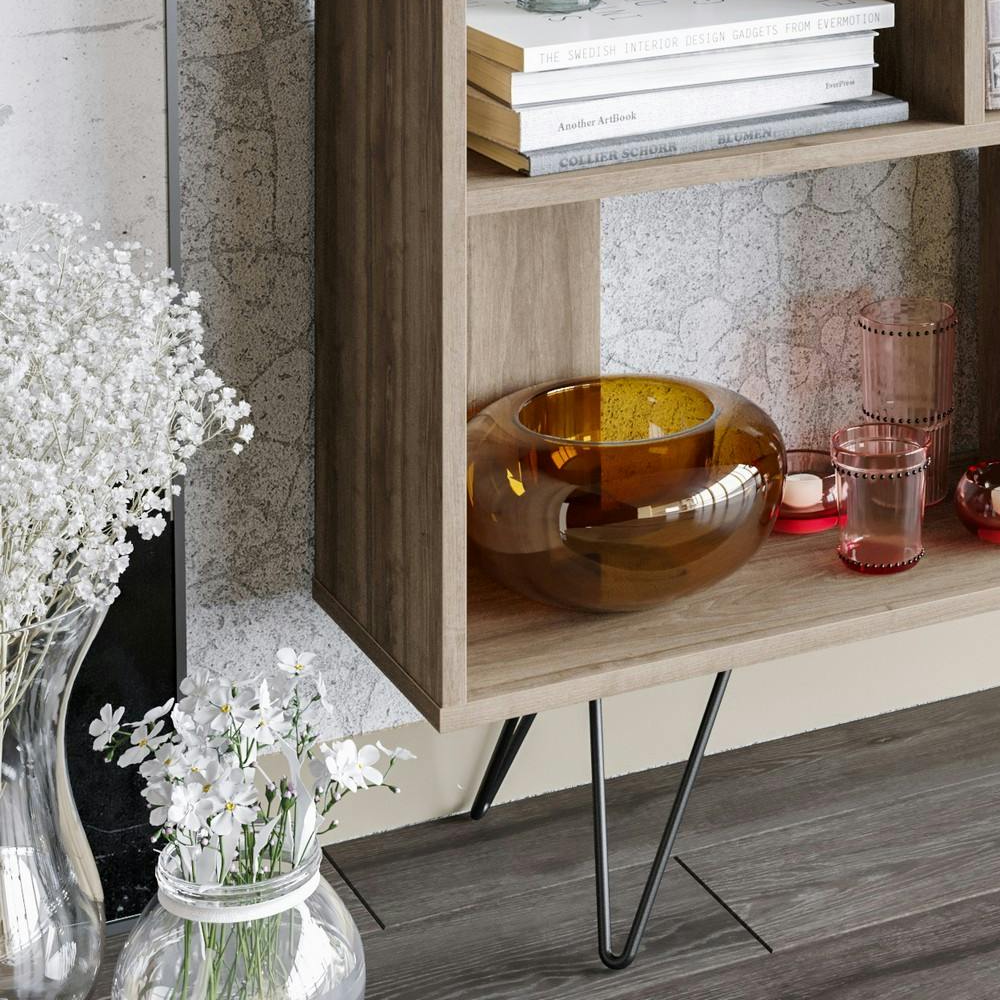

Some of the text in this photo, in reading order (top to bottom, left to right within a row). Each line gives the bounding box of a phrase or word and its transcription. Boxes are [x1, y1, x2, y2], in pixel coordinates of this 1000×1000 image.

[539, 12, 881, 65] THE SWEDISH INTERIOR DESIGN GADGETS FROM EVERMOTION
[558, 111, 637, 132] Another ArtBook
[559, 150, 618, 168] COLLIER
[717, 128, 772, 145] BLUMEN
